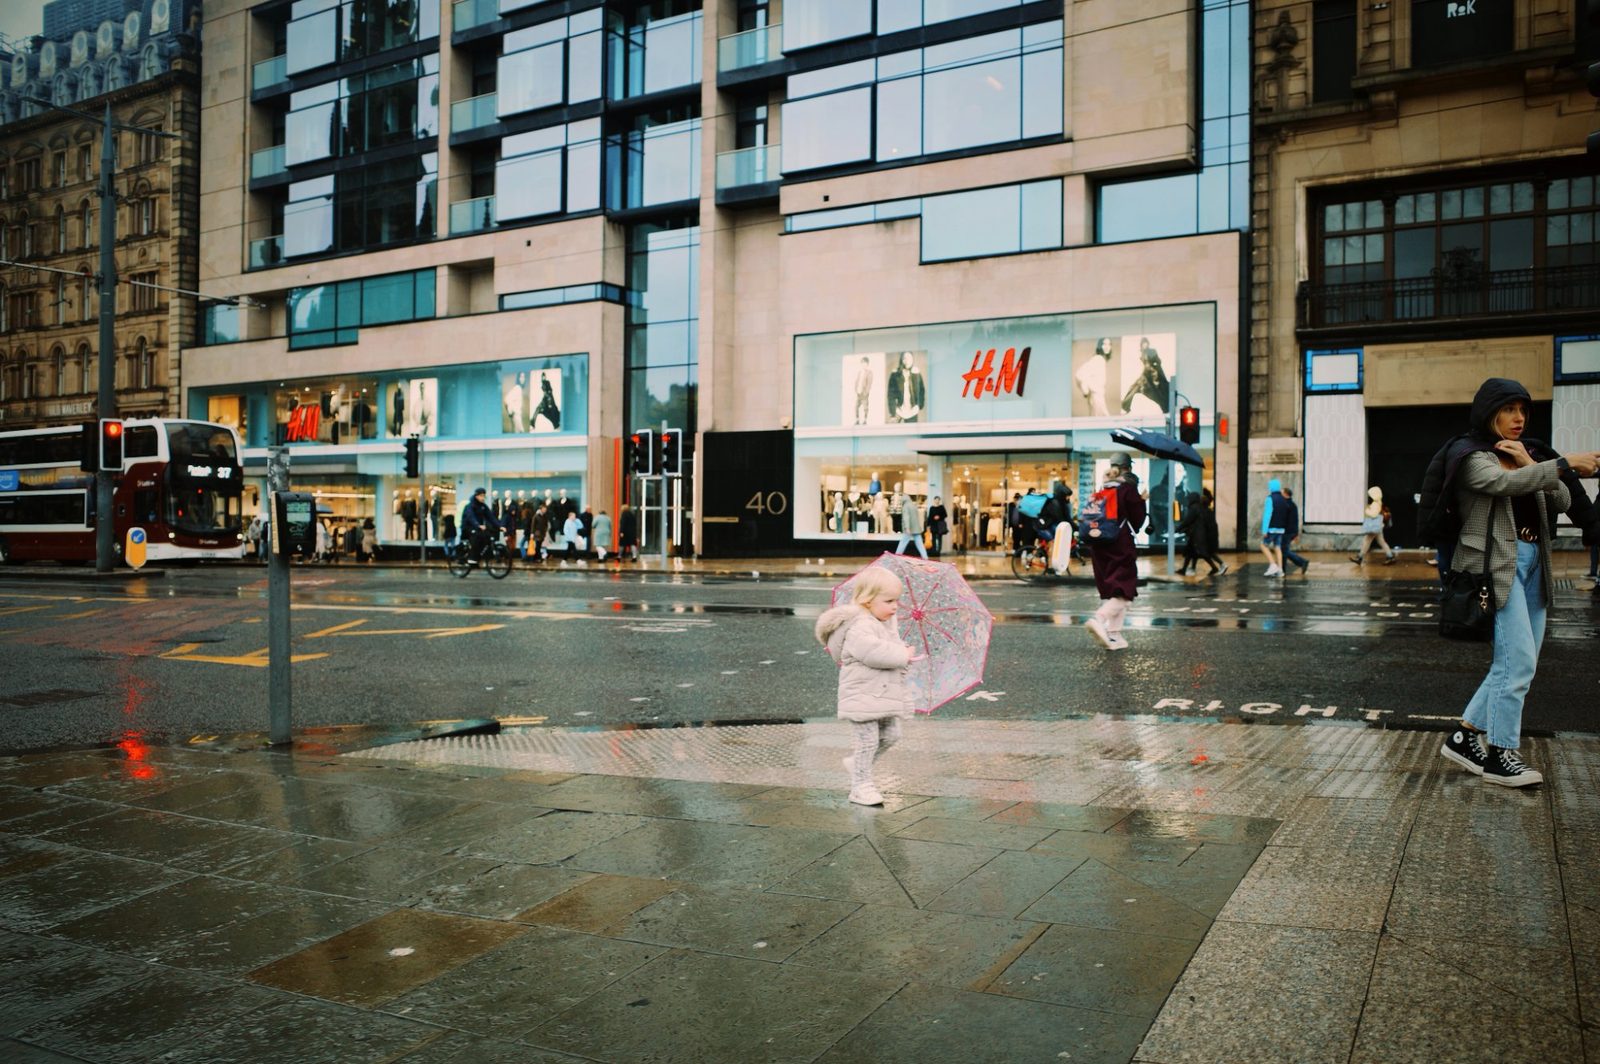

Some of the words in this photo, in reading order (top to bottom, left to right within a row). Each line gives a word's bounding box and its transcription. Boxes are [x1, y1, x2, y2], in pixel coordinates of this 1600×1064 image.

[962, 346, 1032, 400] H&M
[286, 404, 321, 441] H&M
[217, 466, 232, 479] 37
[745, 490, 788, 515] 40
[1152, 698, 1395, 720] RIGHT
